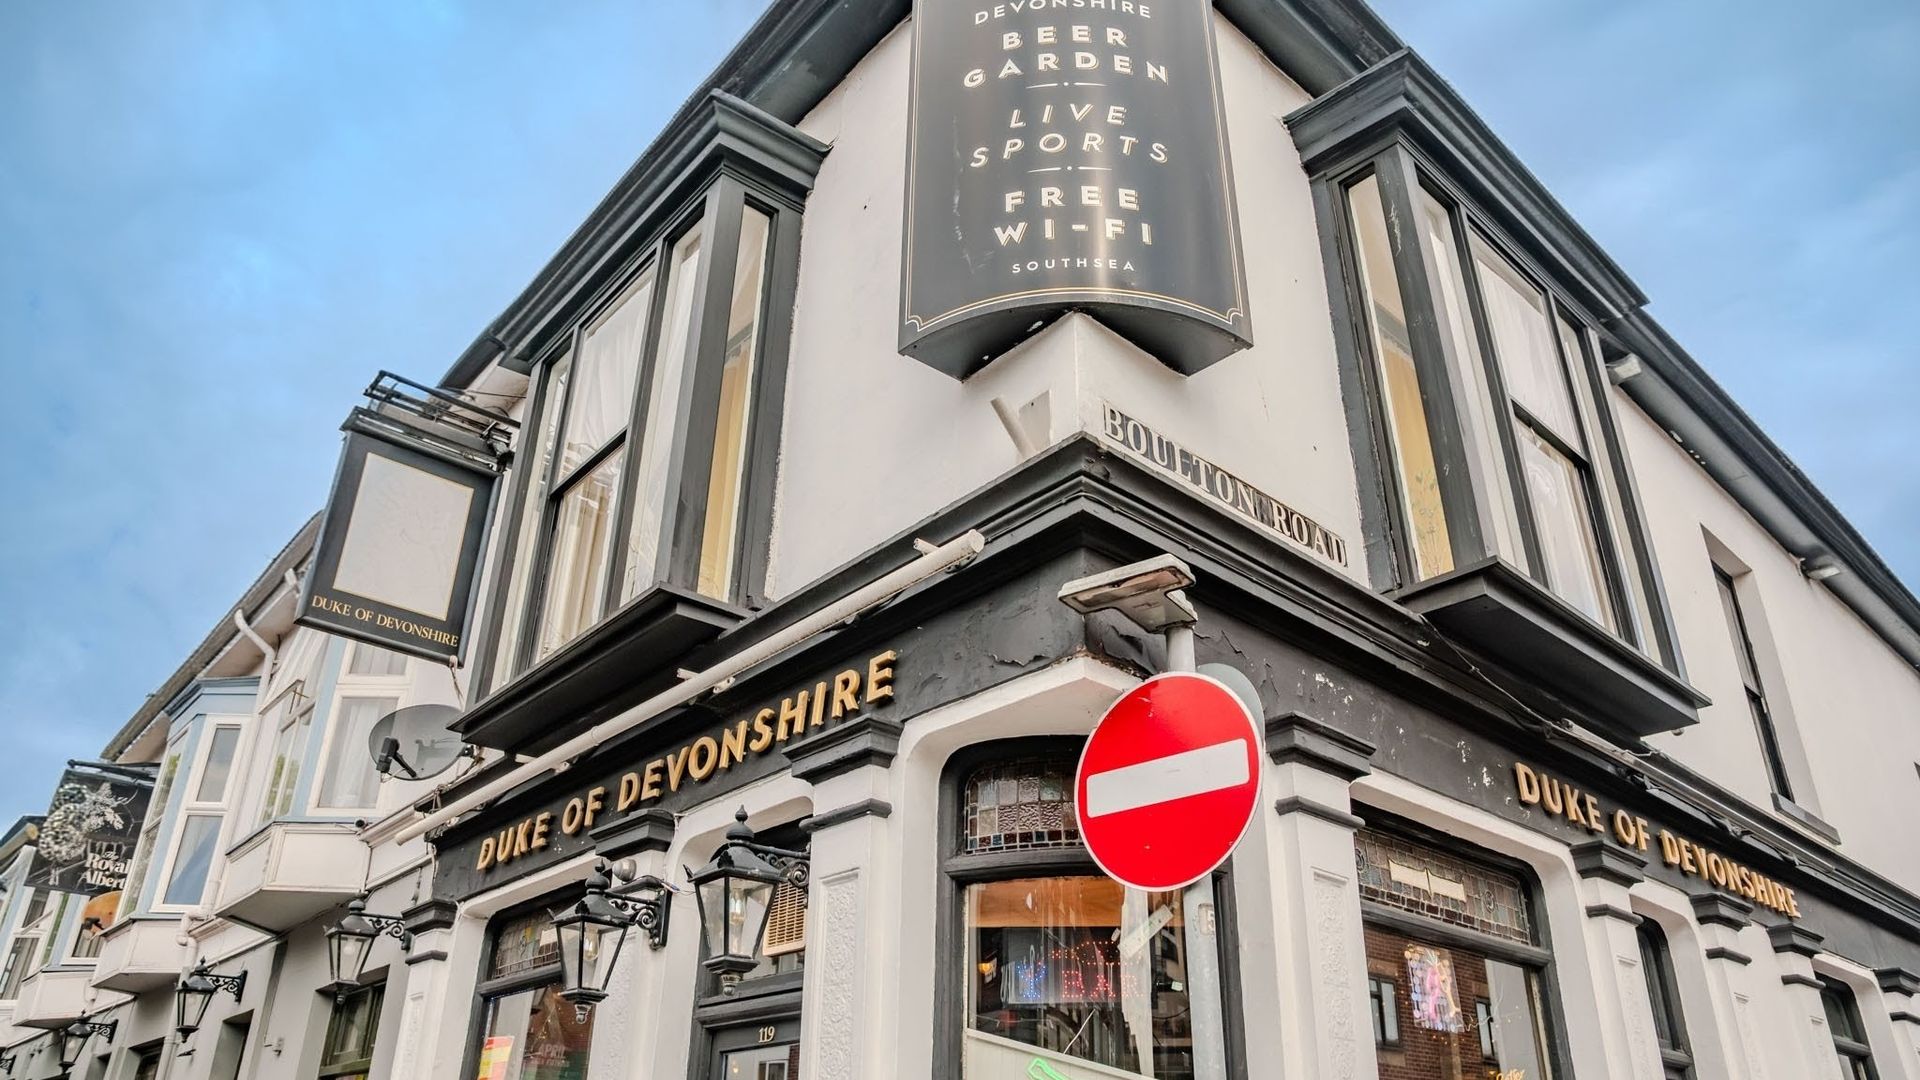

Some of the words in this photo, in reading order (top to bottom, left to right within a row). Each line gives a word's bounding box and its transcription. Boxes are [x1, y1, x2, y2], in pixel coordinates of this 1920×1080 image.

[975, 0, 1151, 25] DEVONSHIRE
[1002, 25, 1128, 50] BEER
[963, 53, 1168, 88] GARDEN
[1010, 104, 1127, 129] LIVE
[970, 133, 1168, 168] SPORTS
[1004, 186, 1140, 213] FREE
[993, 218, 1153, 247] WI-FI
[1011, 258, 1136, 274] SOUTHSEA
[1103, 404, 1258, 518] BOULTON
[1271, 499, 1348, 568] ROAD
[311, 595, 352, 616] DUKE
[355, 607, 375, 622] OF
[376, 613, 460, 647] DEVONSHIRE
[476, 811, 553, 872] DUKE
[561, 786, 606, 835] OF
[616, 649, 898, 812] DEVONSHIRE
[1514, 762, 1605, 833] DUKE
[1612, 808, 1651, 851] OF
[1659, 829, 1802, 919] DEVONSHIRE
[84, 852, 132, 874] Royal
[80, 868, 126, 889] Albert
[1061, 970, 1144, 998] BAR
[758, 1025, 775, 1043] 119
